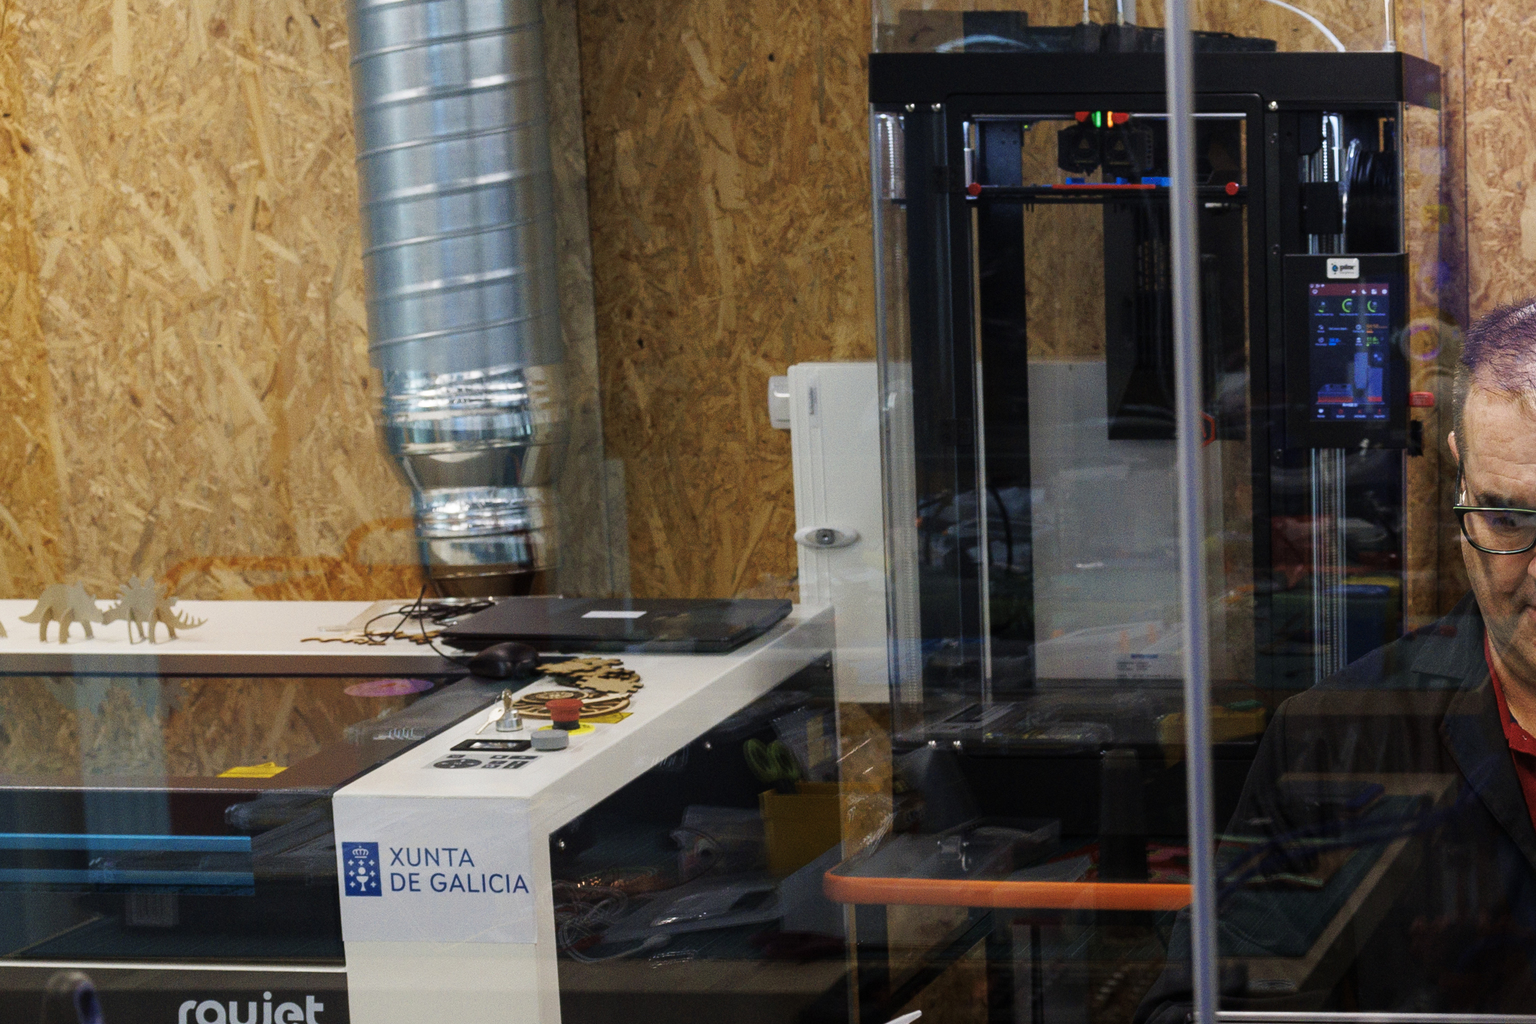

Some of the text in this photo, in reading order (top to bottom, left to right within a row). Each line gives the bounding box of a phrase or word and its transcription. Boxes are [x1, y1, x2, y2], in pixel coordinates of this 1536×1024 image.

[389, 847, 475, 867] XUNTA
[390, 872, 530, 893] DE GALICIA
